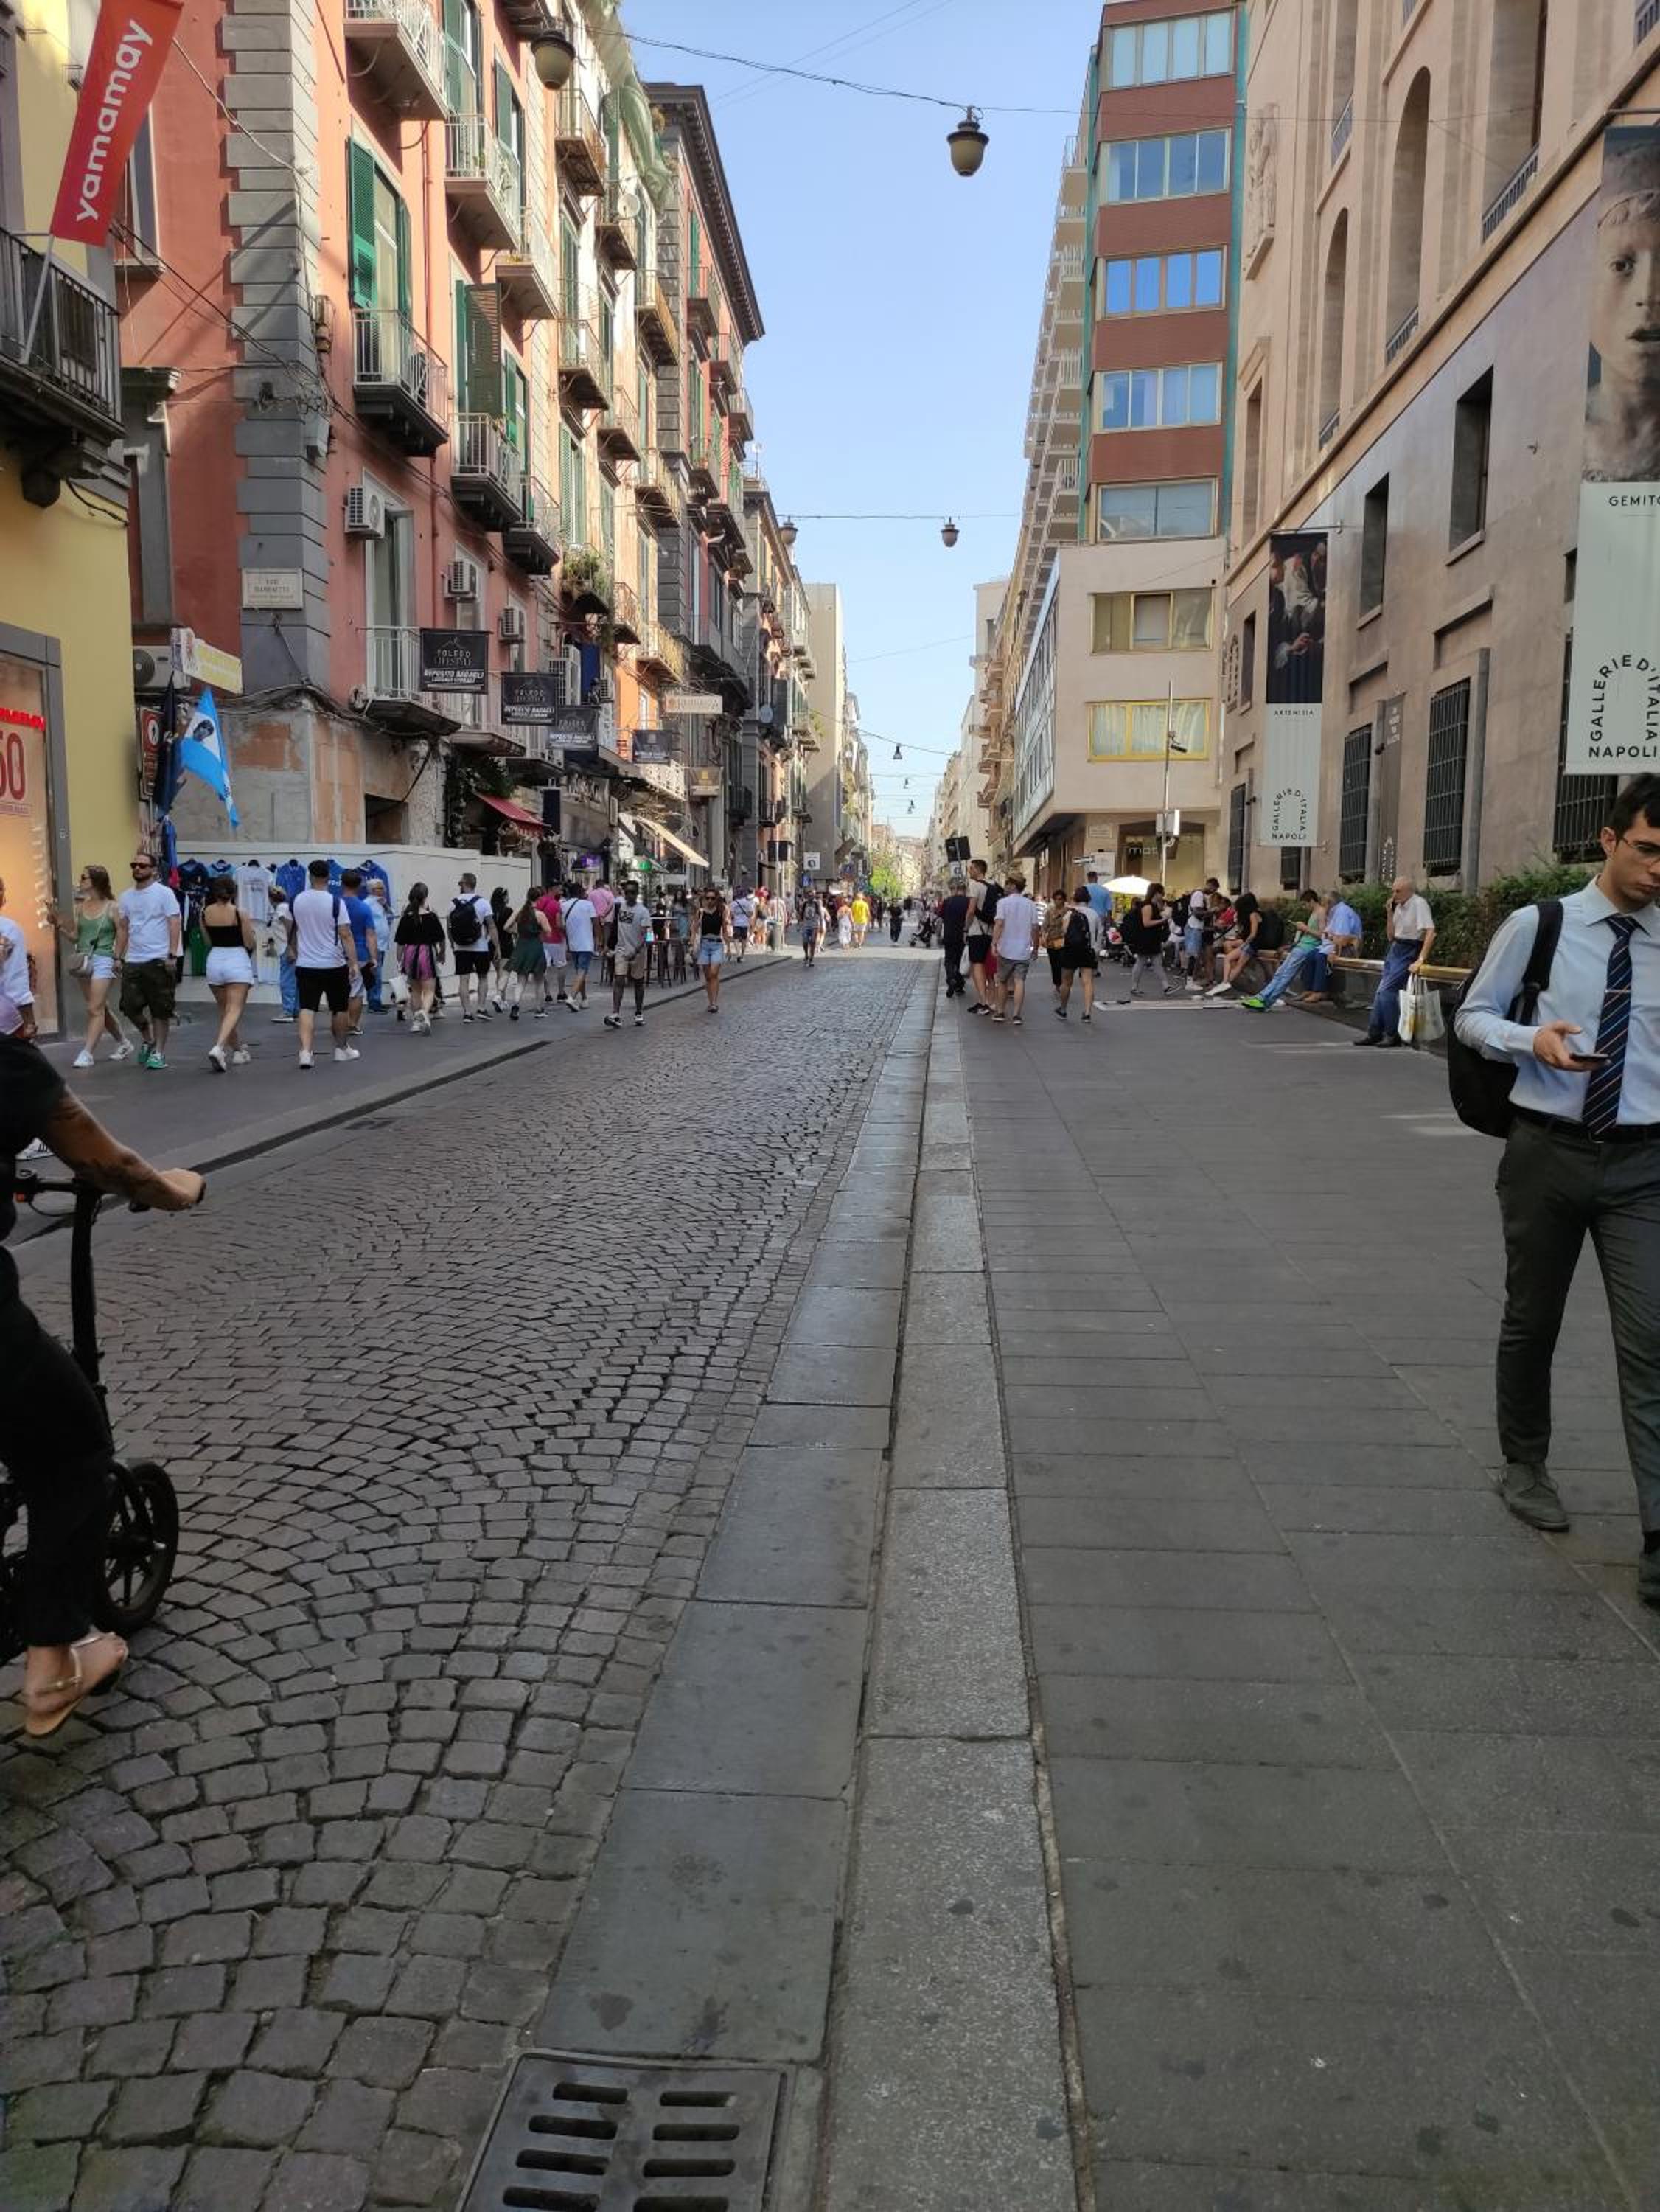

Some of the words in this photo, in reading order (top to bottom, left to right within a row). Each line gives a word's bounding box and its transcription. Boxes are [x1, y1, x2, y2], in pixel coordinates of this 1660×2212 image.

[76, 18, 153, 221] yamamay
[1590, 654, 1632, 742] GALLERIE
[1588, 745, 1658, 758] NAPOLI
[1272, 832, 1306, 841] NAPOLI
